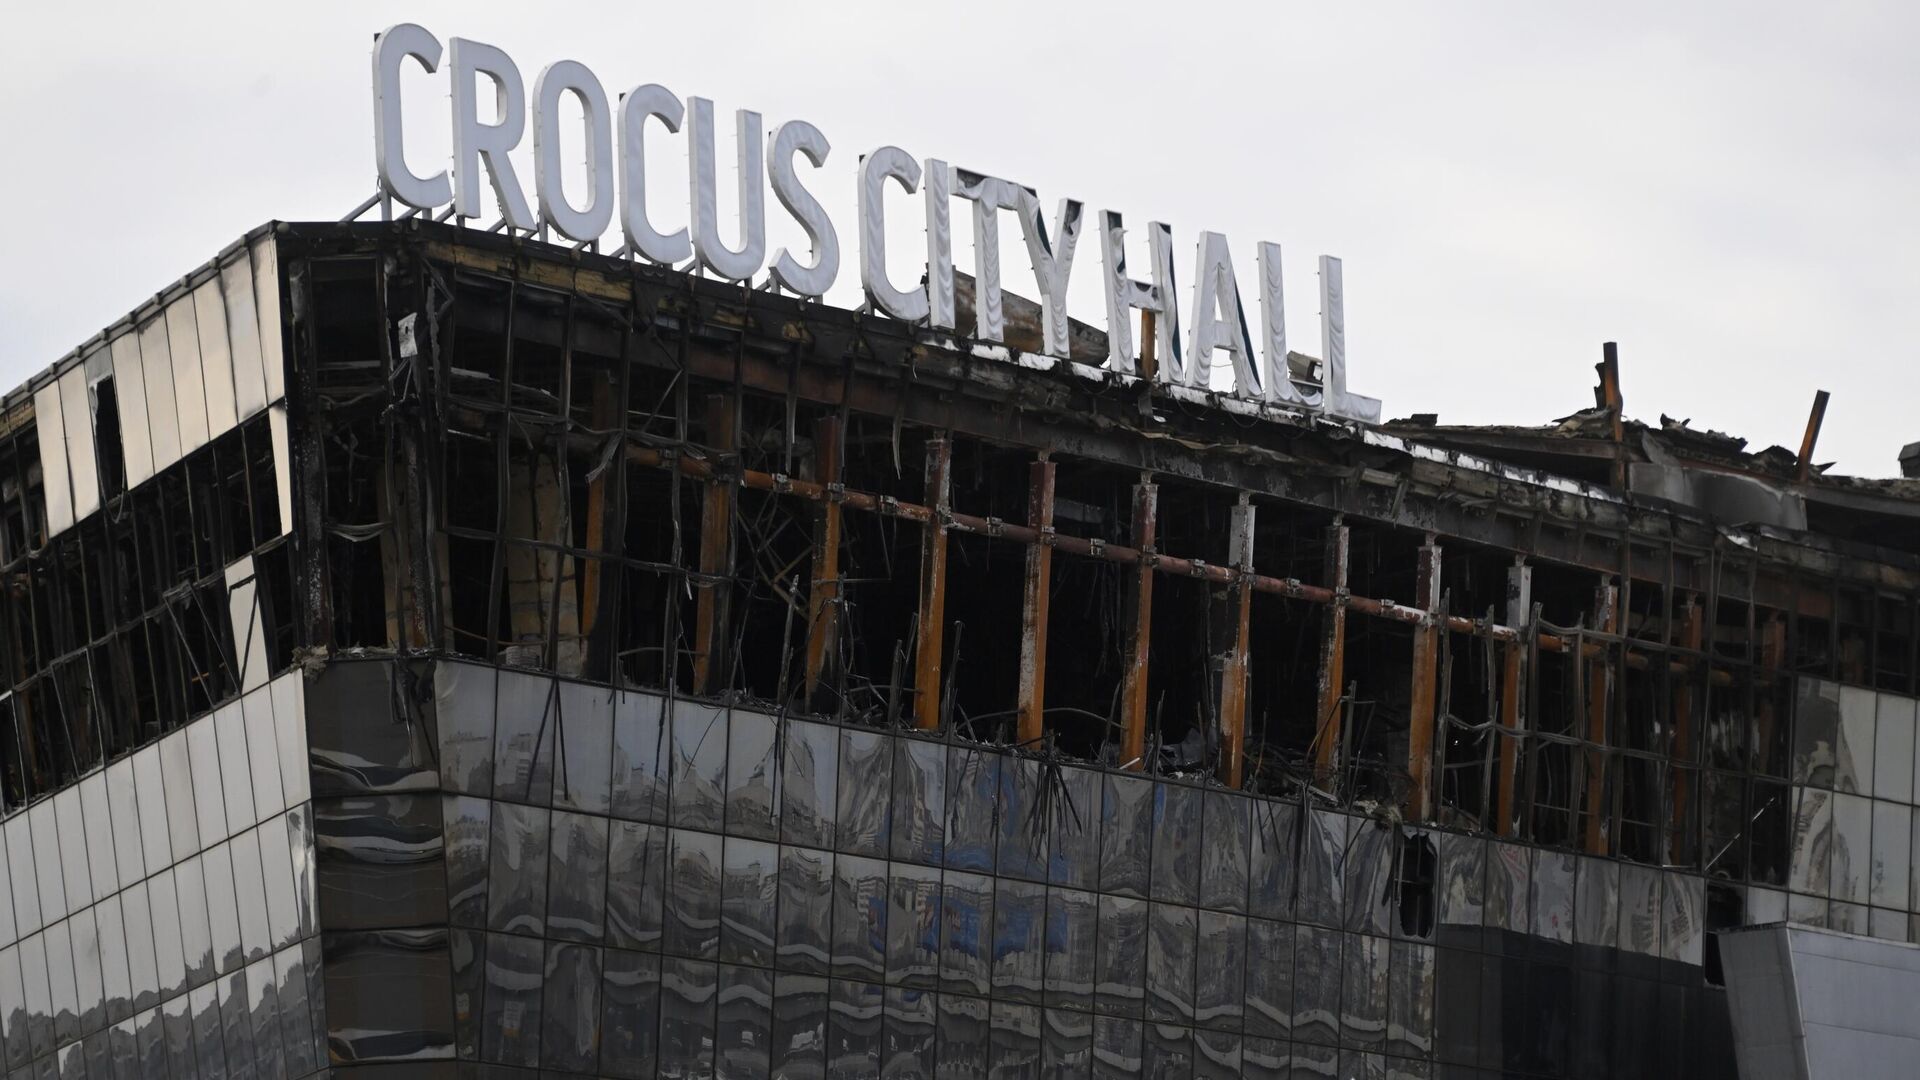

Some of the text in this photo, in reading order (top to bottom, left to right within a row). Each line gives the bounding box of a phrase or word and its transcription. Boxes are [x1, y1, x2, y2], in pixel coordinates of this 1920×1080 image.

[372, 23, 1382, 425] CROCUS CITY HALL
